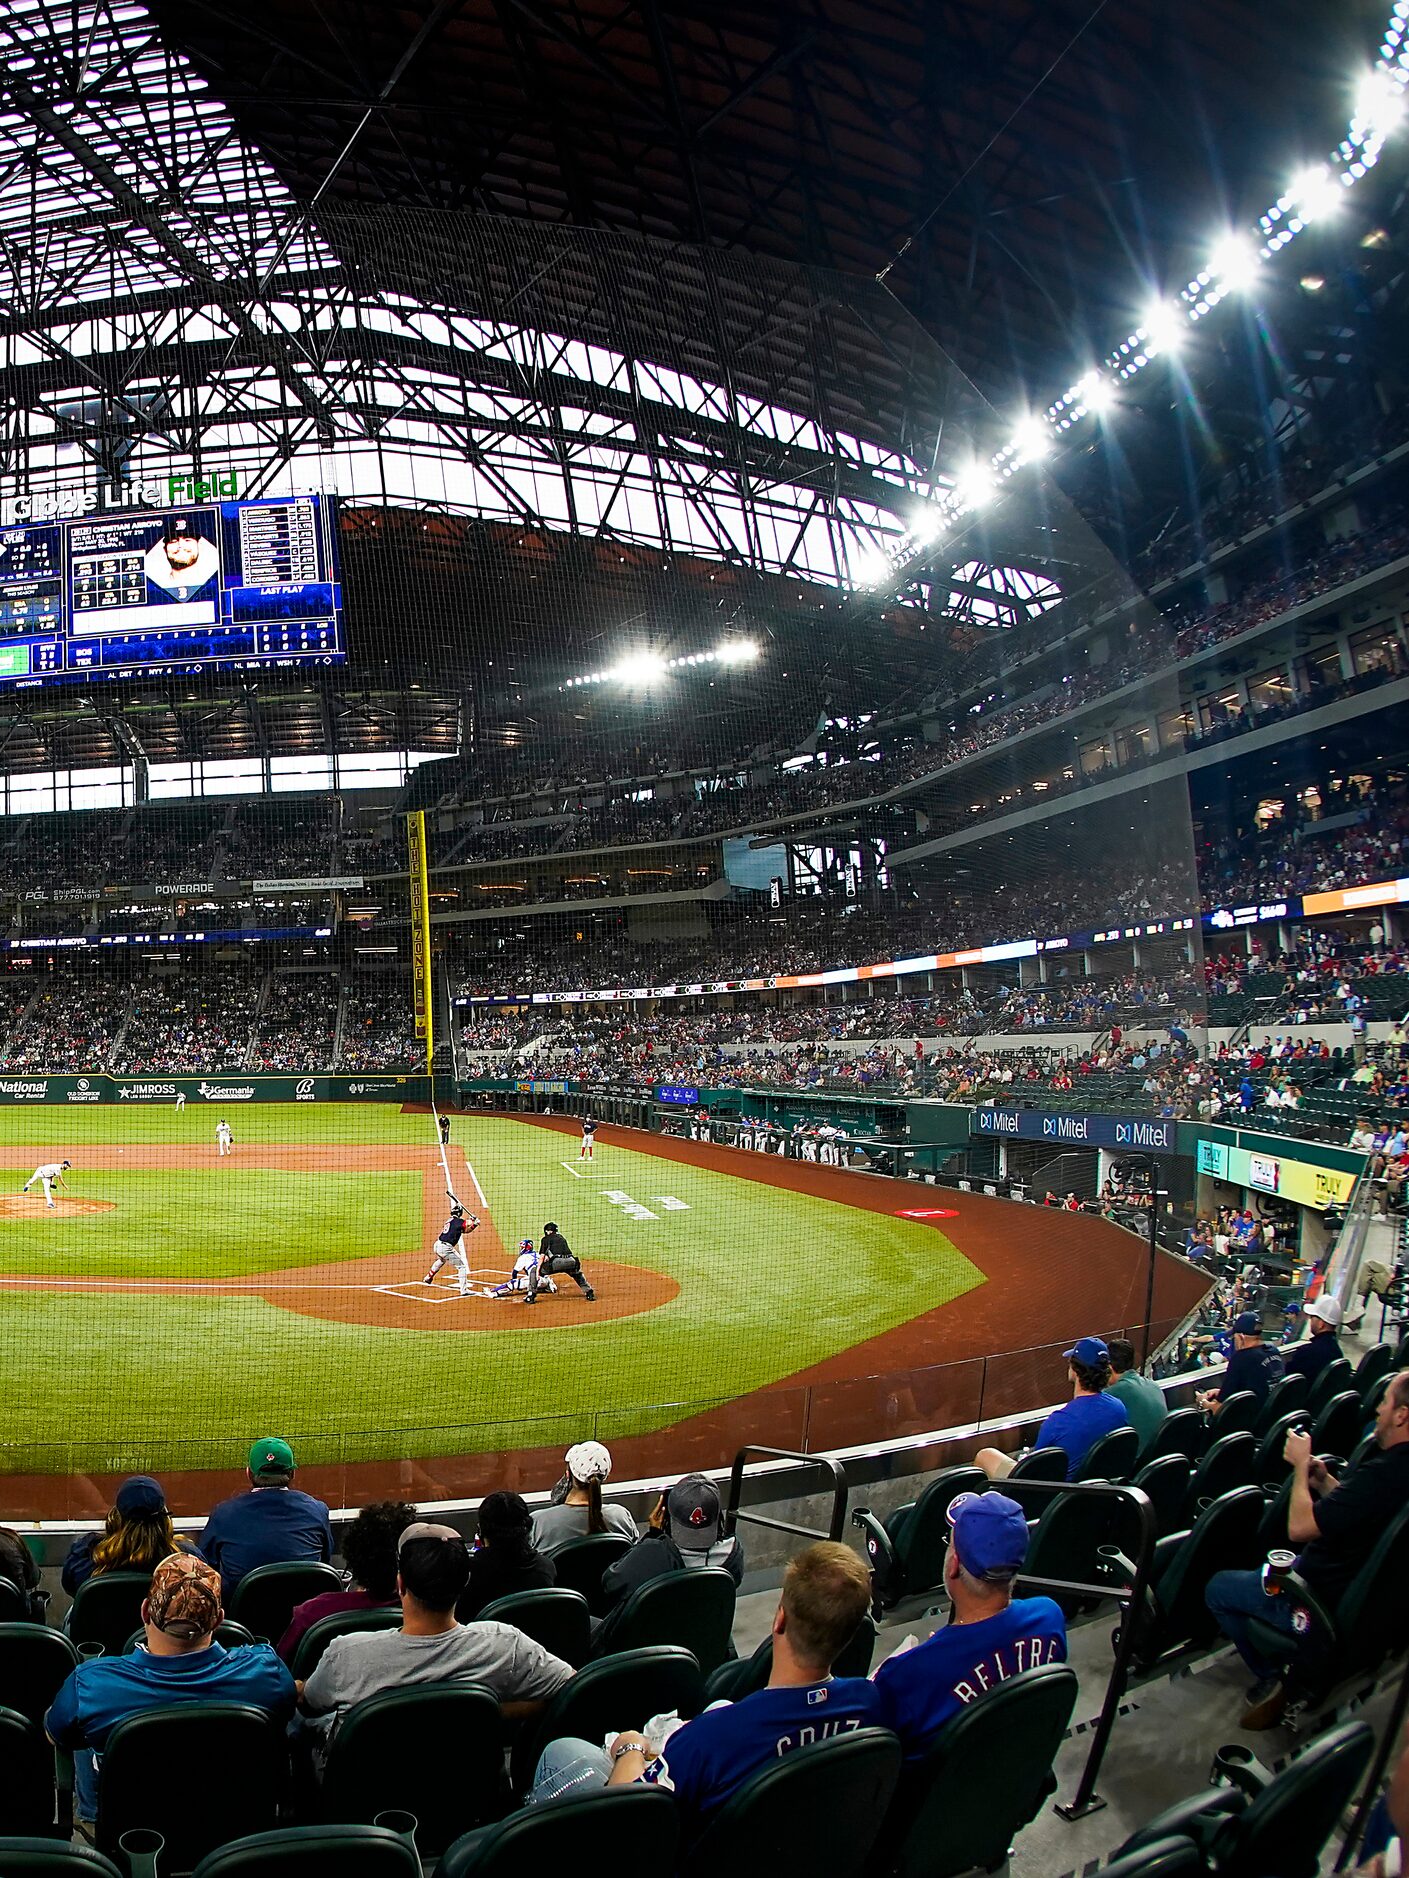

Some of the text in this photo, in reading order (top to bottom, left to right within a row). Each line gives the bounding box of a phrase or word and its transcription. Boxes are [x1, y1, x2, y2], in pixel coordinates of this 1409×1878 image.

[10, 471, 238, 521] Globe Life Field
[261, 586, 304, 595] LAST PLAY
[76, 658, 91, 666] TEX
[277, 658, 293, 667] WSH
[16, 680, 42, 688] DISTANCE
[25, 891, 49, 900] PGL
[155, 883, 215, 894] POWERADE
[410, 837, 424, 980] THE HOT ZONE
[20, 938, 56, 947] CHRISTIAN
[56, 937, 87, 945] ARROYO
[214, 1085, 254, 1096] Germania
[993, 1112, 1019, 1132] Mitel
[1058, 1117, 1088, 1139] Mitel
[1133, 1123, 1168, 1147] Mitel
[1203, 1146, 1221, 1163] TRULY
[1254, 1160, 1273, 1177] TRULY
[1316, 1173, 1342, 1196] TRULY
